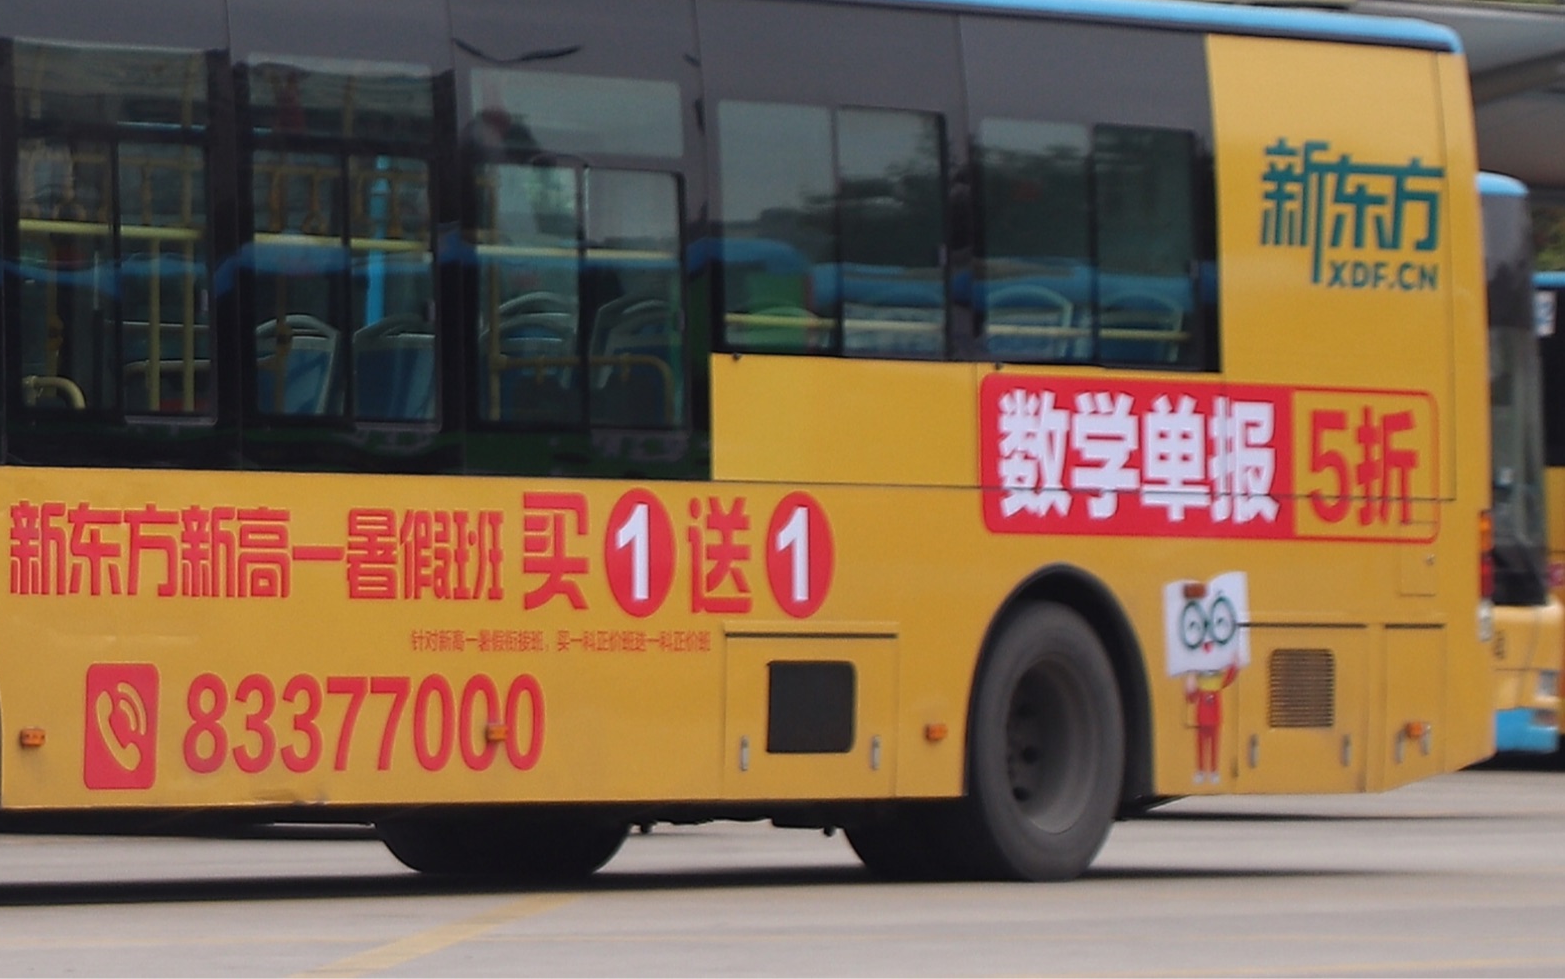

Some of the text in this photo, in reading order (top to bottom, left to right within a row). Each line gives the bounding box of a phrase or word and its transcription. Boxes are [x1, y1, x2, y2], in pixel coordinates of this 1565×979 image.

[1259, 138, 1444, 285] 新东方
[1327, 261, 1438, 291] XDF.CN
[998, 389, 1419, 527] 数学单报 5折
[9, 500, 504, 601] 新东方新高一暑假班
[183, 672, 546, 774] 83377000
